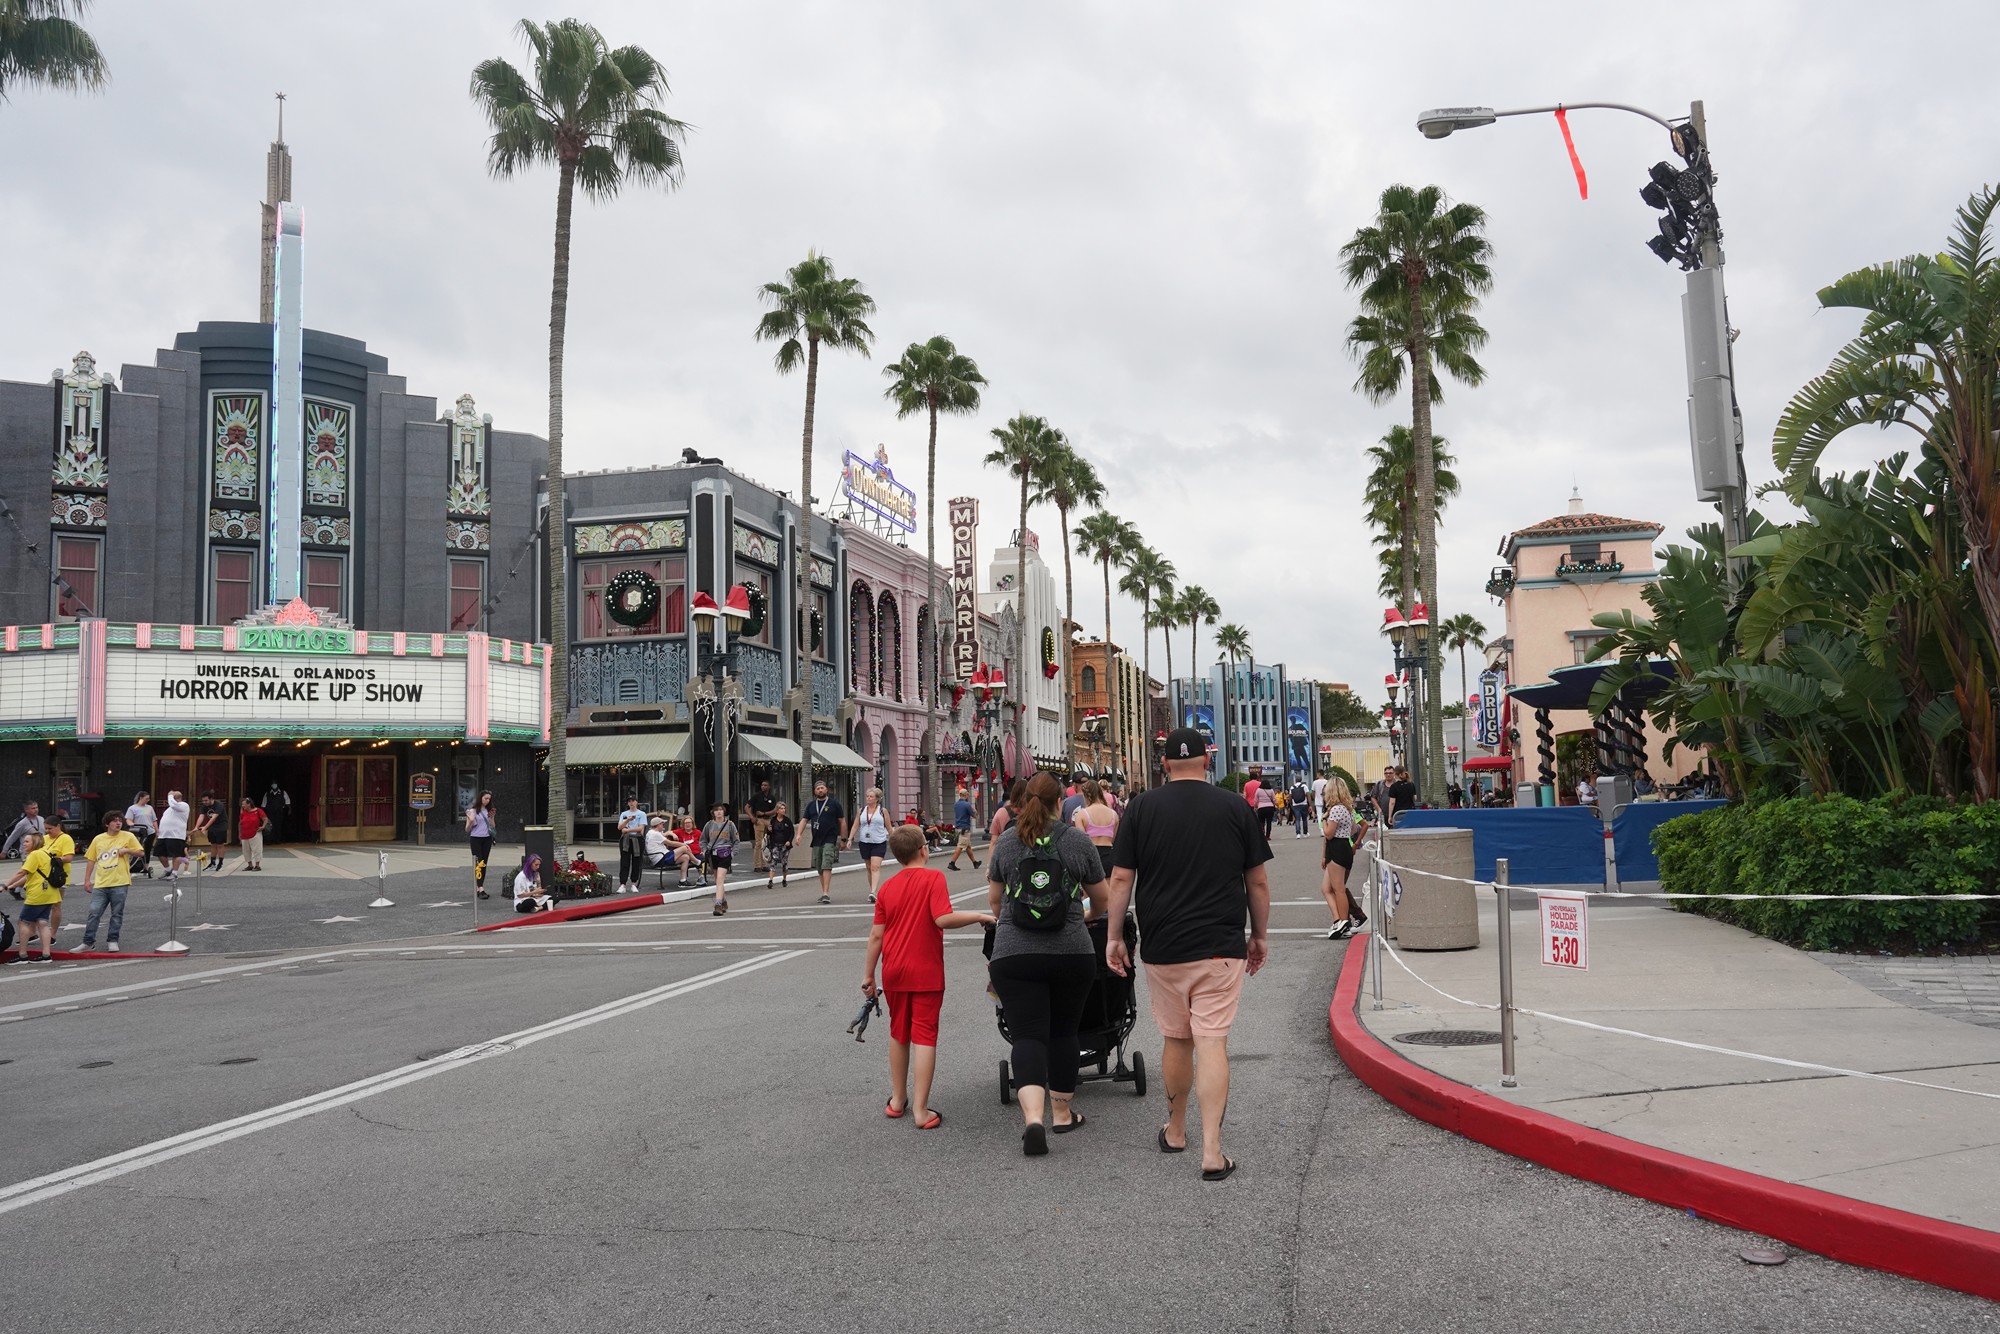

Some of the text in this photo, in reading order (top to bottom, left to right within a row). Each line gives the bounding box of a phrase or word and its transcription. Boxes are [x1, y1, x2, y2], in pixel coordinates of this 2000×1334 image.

[953, 509, 973, 677] MONTMARTRE
[244, 630, 349, 650] PANTAGES
[197, 665, 375, 680] UNIVERSAL ORLANDO'S
[160, 679, 423, 703] HORROR MAKE UP SHOW
[1484, 685, 1498, 743] DRUGS
[1550, 912, 1577, 921] HOLIDAY
[1551, 920, 1578, 931] PARADE
[1552, 936, 1578, 965] 5:30
